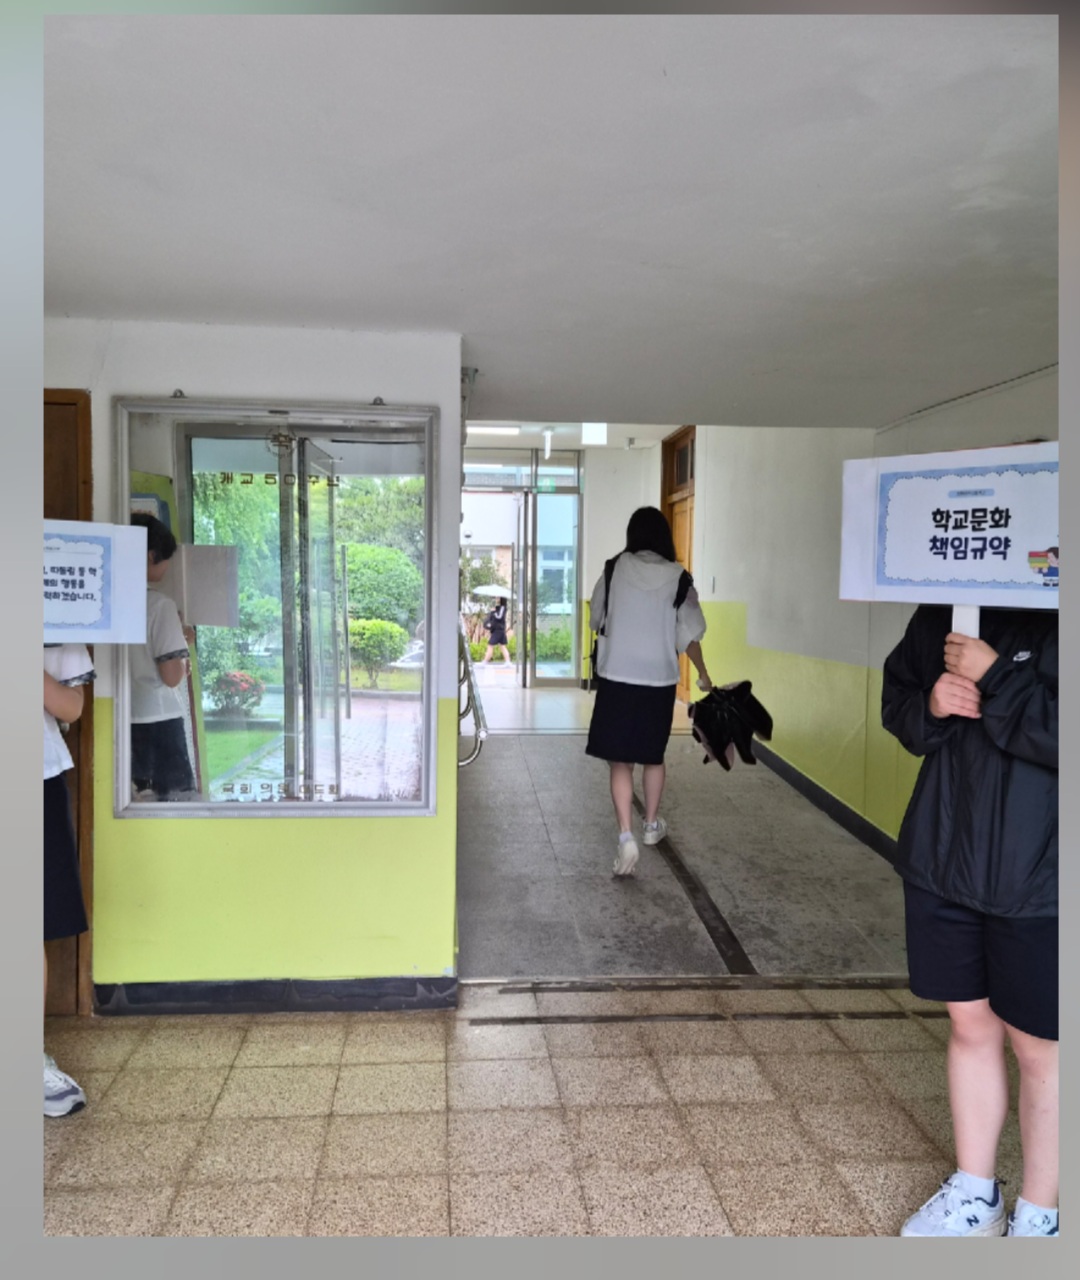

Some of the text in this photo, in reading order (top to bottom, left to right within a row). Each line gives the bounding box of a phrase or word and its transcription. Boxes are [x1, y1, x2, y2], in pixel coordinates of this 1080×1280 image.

[220, 472, 254, 485] 개교
[931, 506, 1012, 533] 학교문화
[929, 535, 1012, 561] 책임규약
[61, 578, 86, 590] 행동을
